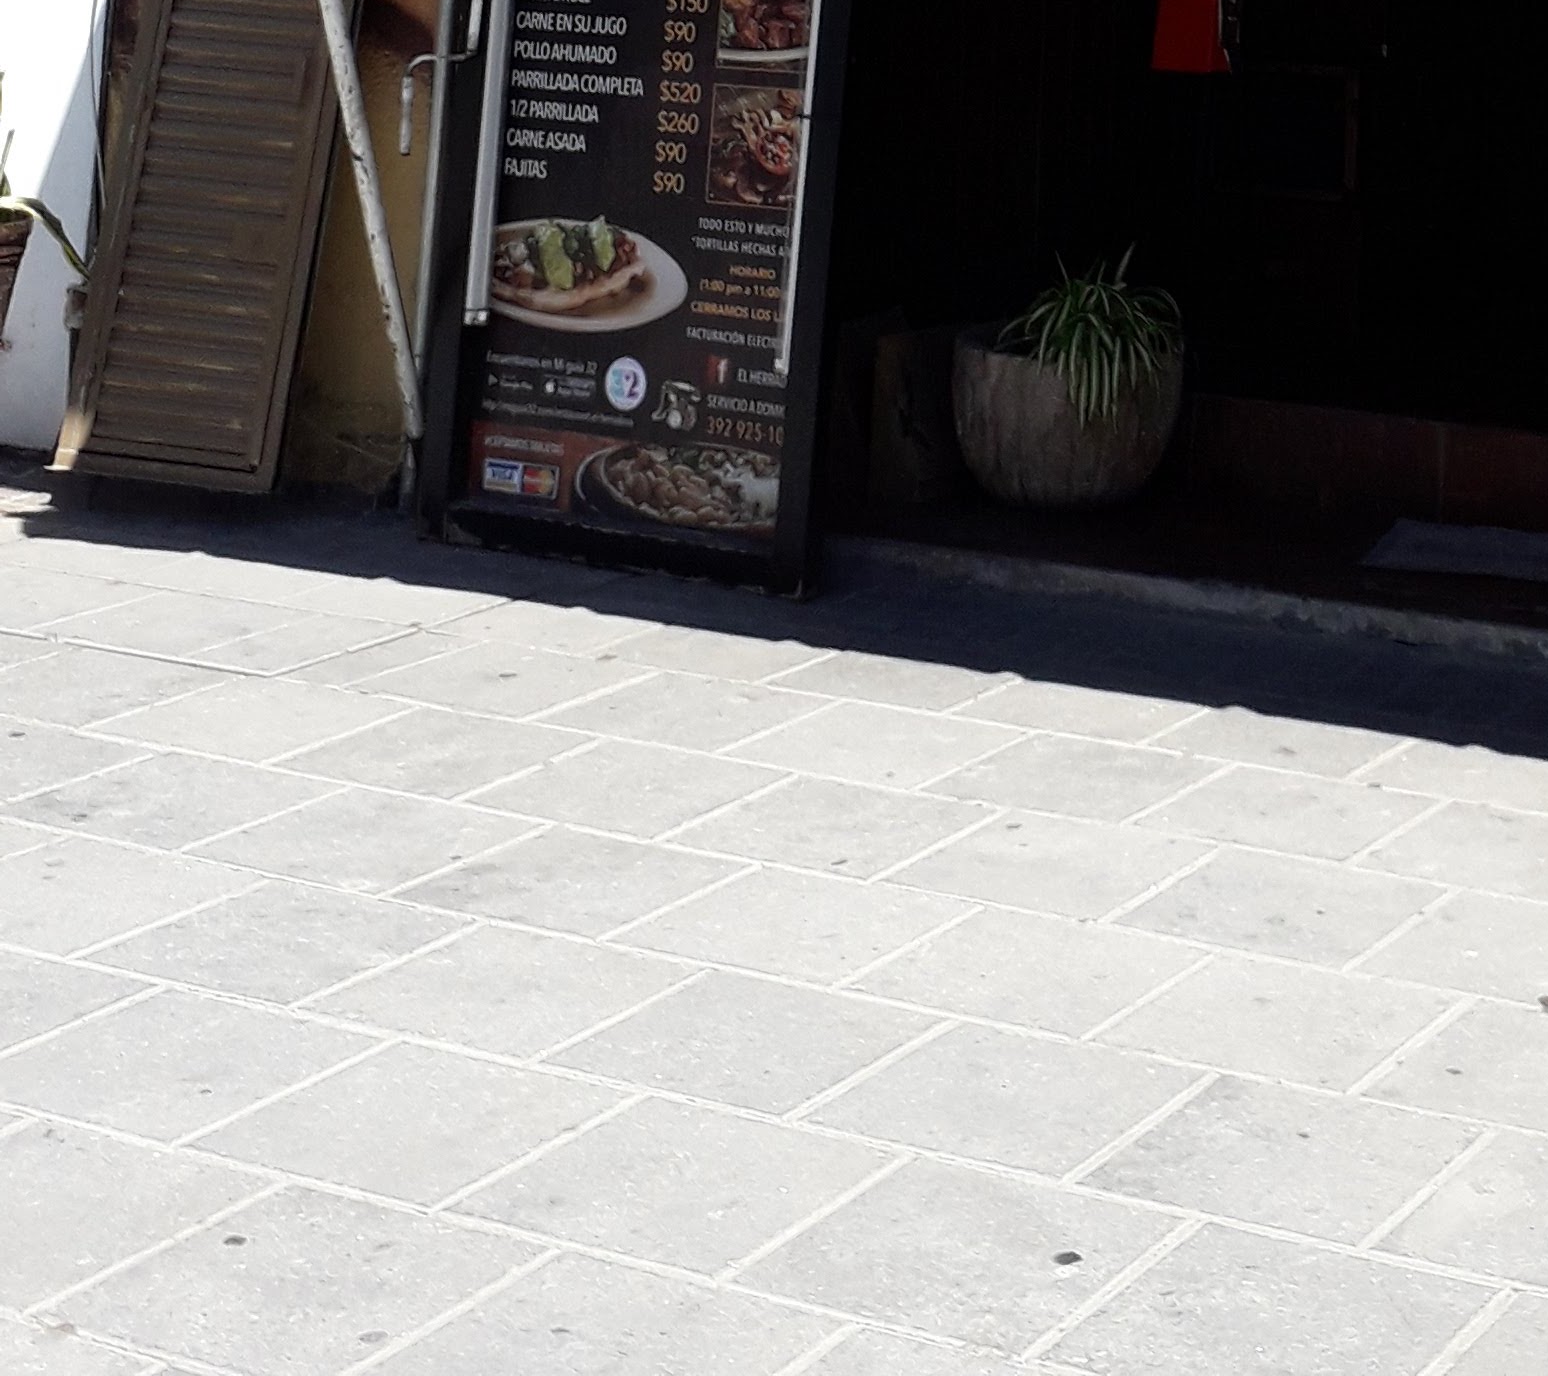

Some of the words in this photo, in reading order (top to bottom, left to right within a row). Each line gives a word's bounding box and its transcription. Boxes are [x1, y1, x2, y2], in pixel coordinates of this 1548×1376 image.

[516, 11, 554, 30] CARNE
[556, 13, 574, 31] EN
[574, 14, 592, 33] SU
[591, 16, 627, 36] JUGO
[663, 20, 697, 44] $90
[513, 40, 551, 60] POLLO
[551, 44, 618, 65] AHUMADO
[661, 49, 694, 74] $90
[511, 69, 580, 92] PARRILLADA
[580, 75, 645, 97] COMPLETA
[659, 81, 702, 104] $520
[510, 99, 529, 117] 1/2
[529, 101, 600, 124] PARRILLADA
[656, 110, 700, 135] $260
[506, 128, 545, 149] CARNE
[545, 131, 587, 153] ASADA
[655, 139, 688, 165] $90
[504, 157, 548, 179] FAJITAS
[652, 170, 685, 194] $90
